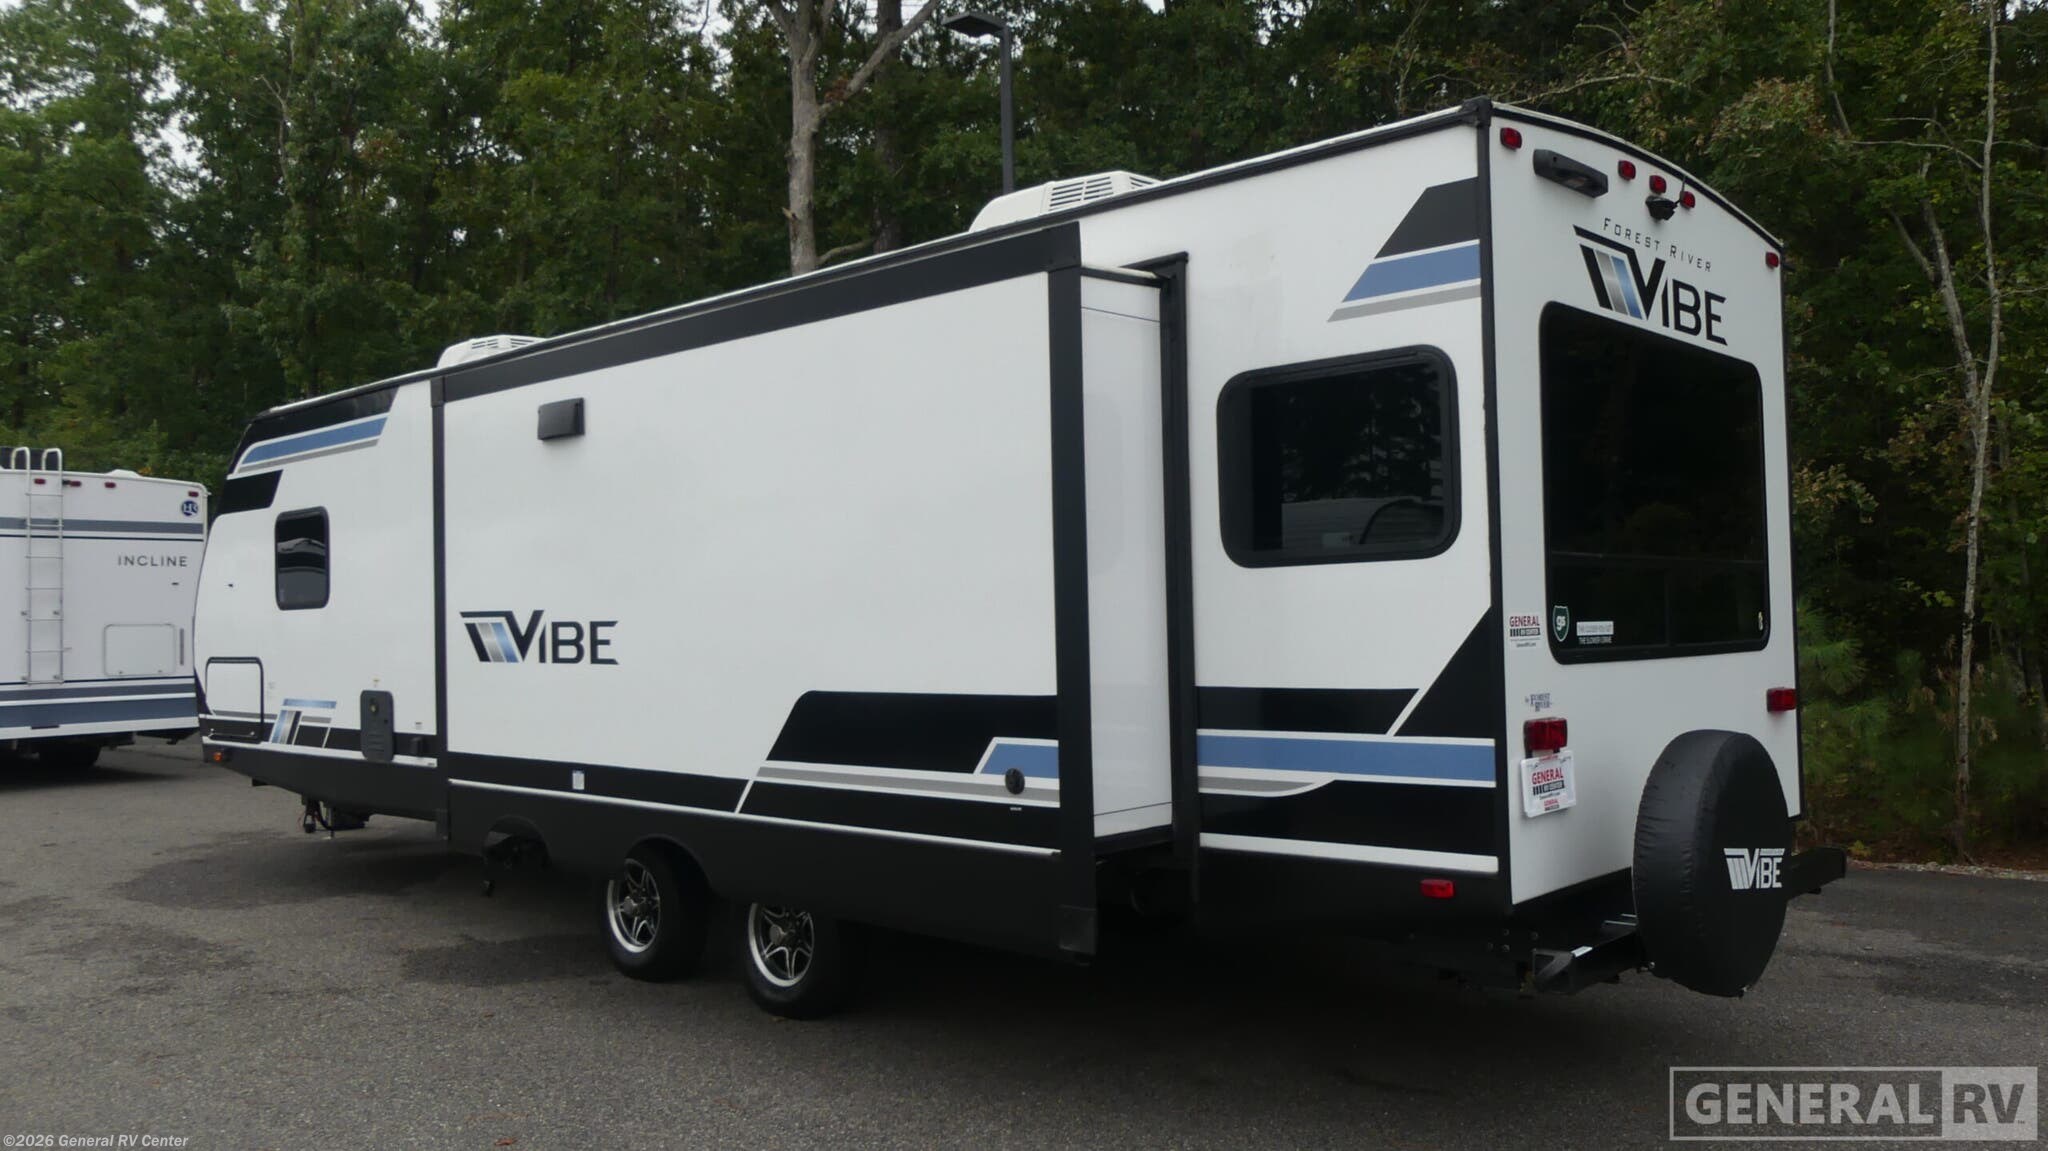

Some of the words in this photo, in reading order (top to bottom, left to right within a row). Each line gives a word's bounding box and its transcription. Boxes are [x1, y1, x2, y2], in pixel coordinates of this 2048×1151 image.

[1602, 217, 1660, 251] FOREST
[1669, 244, 1712, 273] RIVER
[1572, 223, 1728, 346] VIBE
[117, 554, 188, 567] INCLINE
[459, 609, 619, 665] VIBE
[1509, 615, 1540, 628] GENERAL
[1531, 767, 1564, 785] GENERAL
[1723, 847, 1783, 890] VIBE
